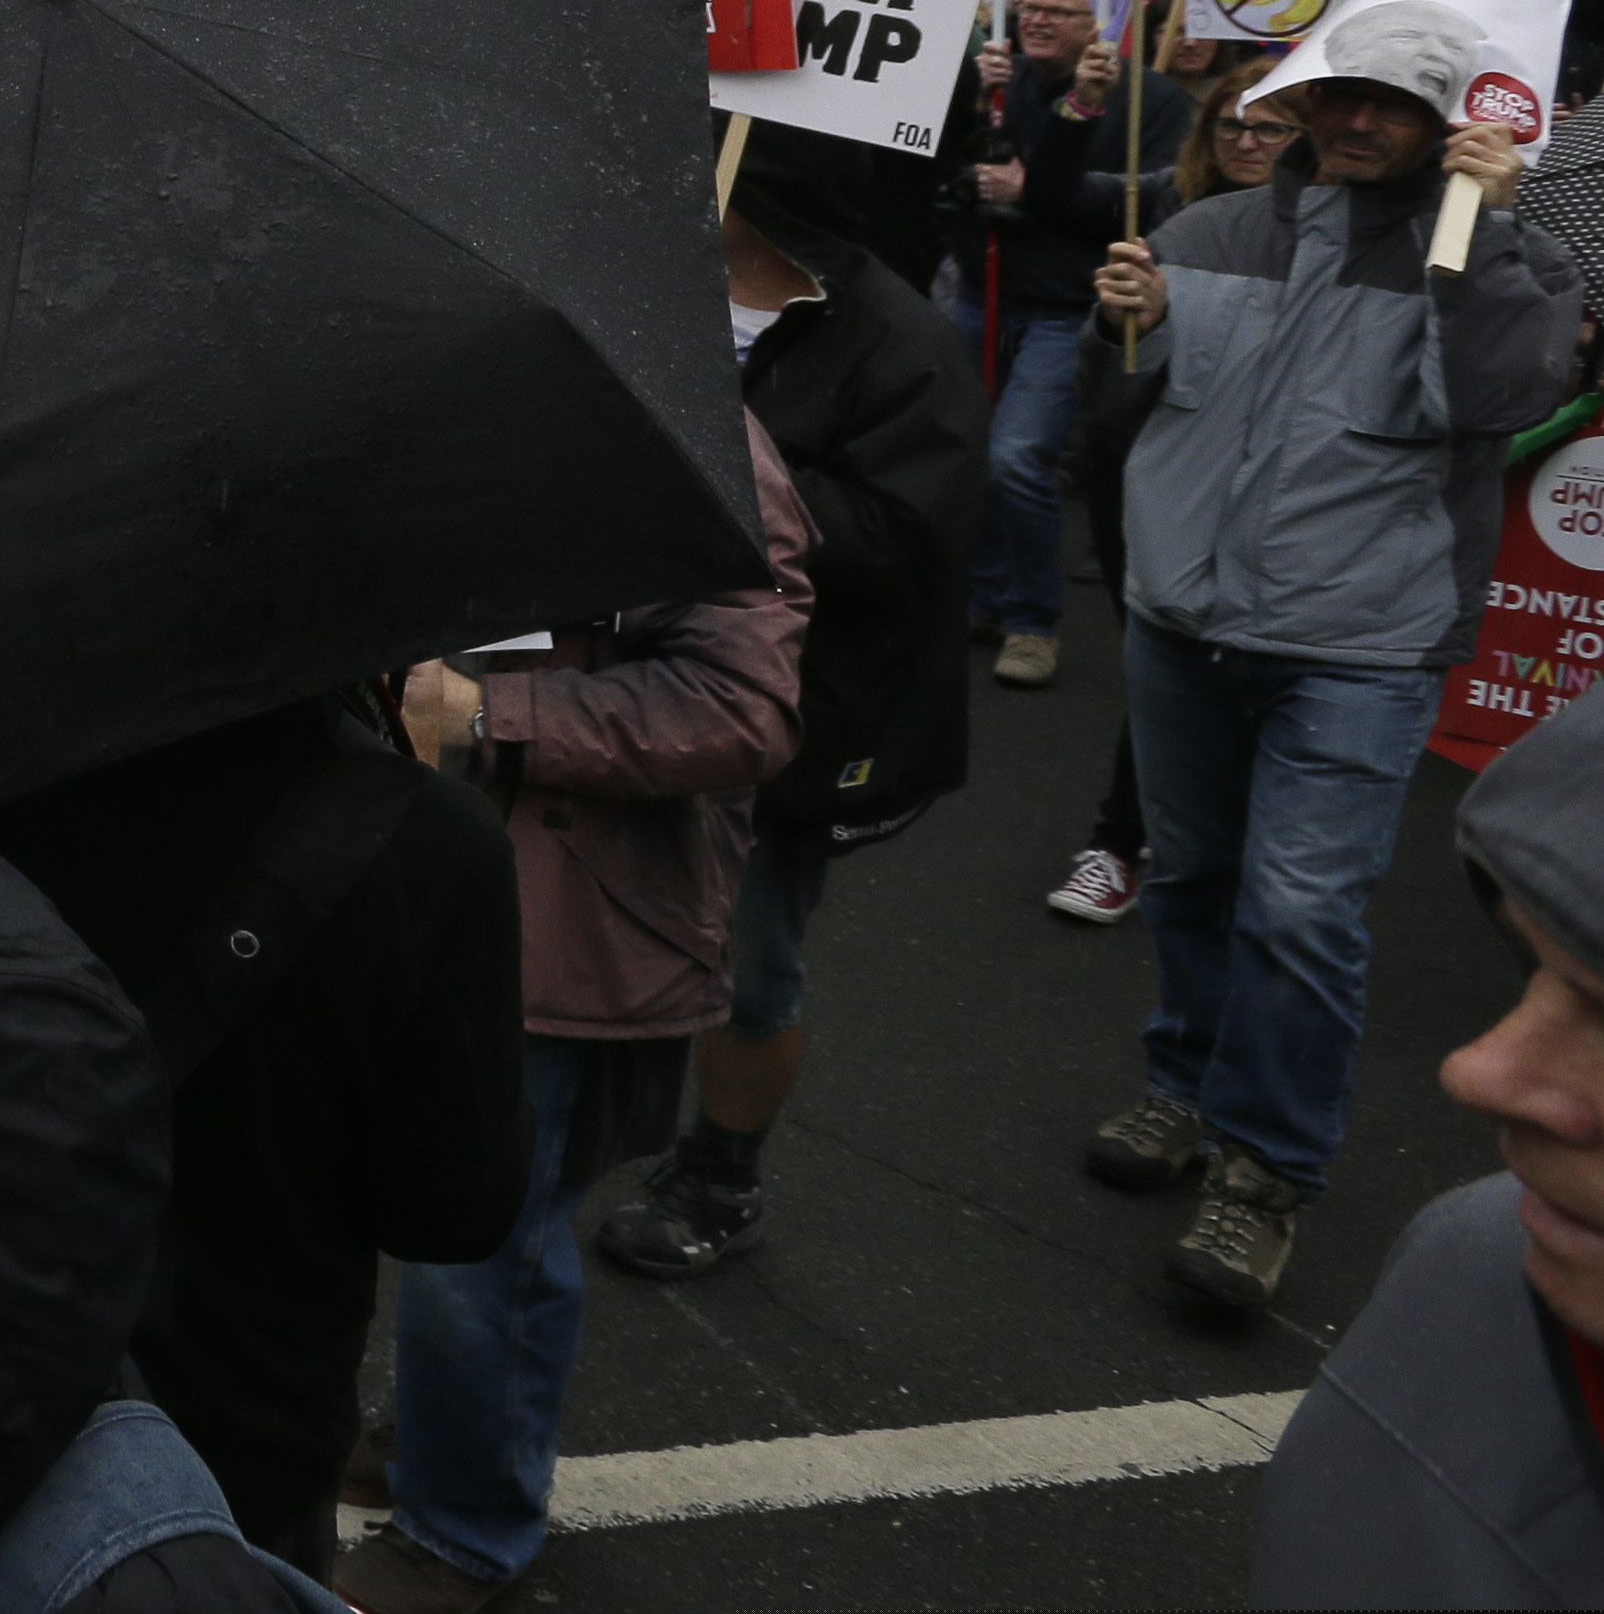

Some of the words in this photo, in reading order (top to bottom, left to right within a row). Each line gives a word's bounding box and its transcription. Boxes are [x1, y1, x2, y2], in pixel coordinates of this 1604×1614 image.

[1484, 83, 1534, 112] STOP
[893, 121, 931, 151] FOA
[1467, 678, 1535, 719] THE
